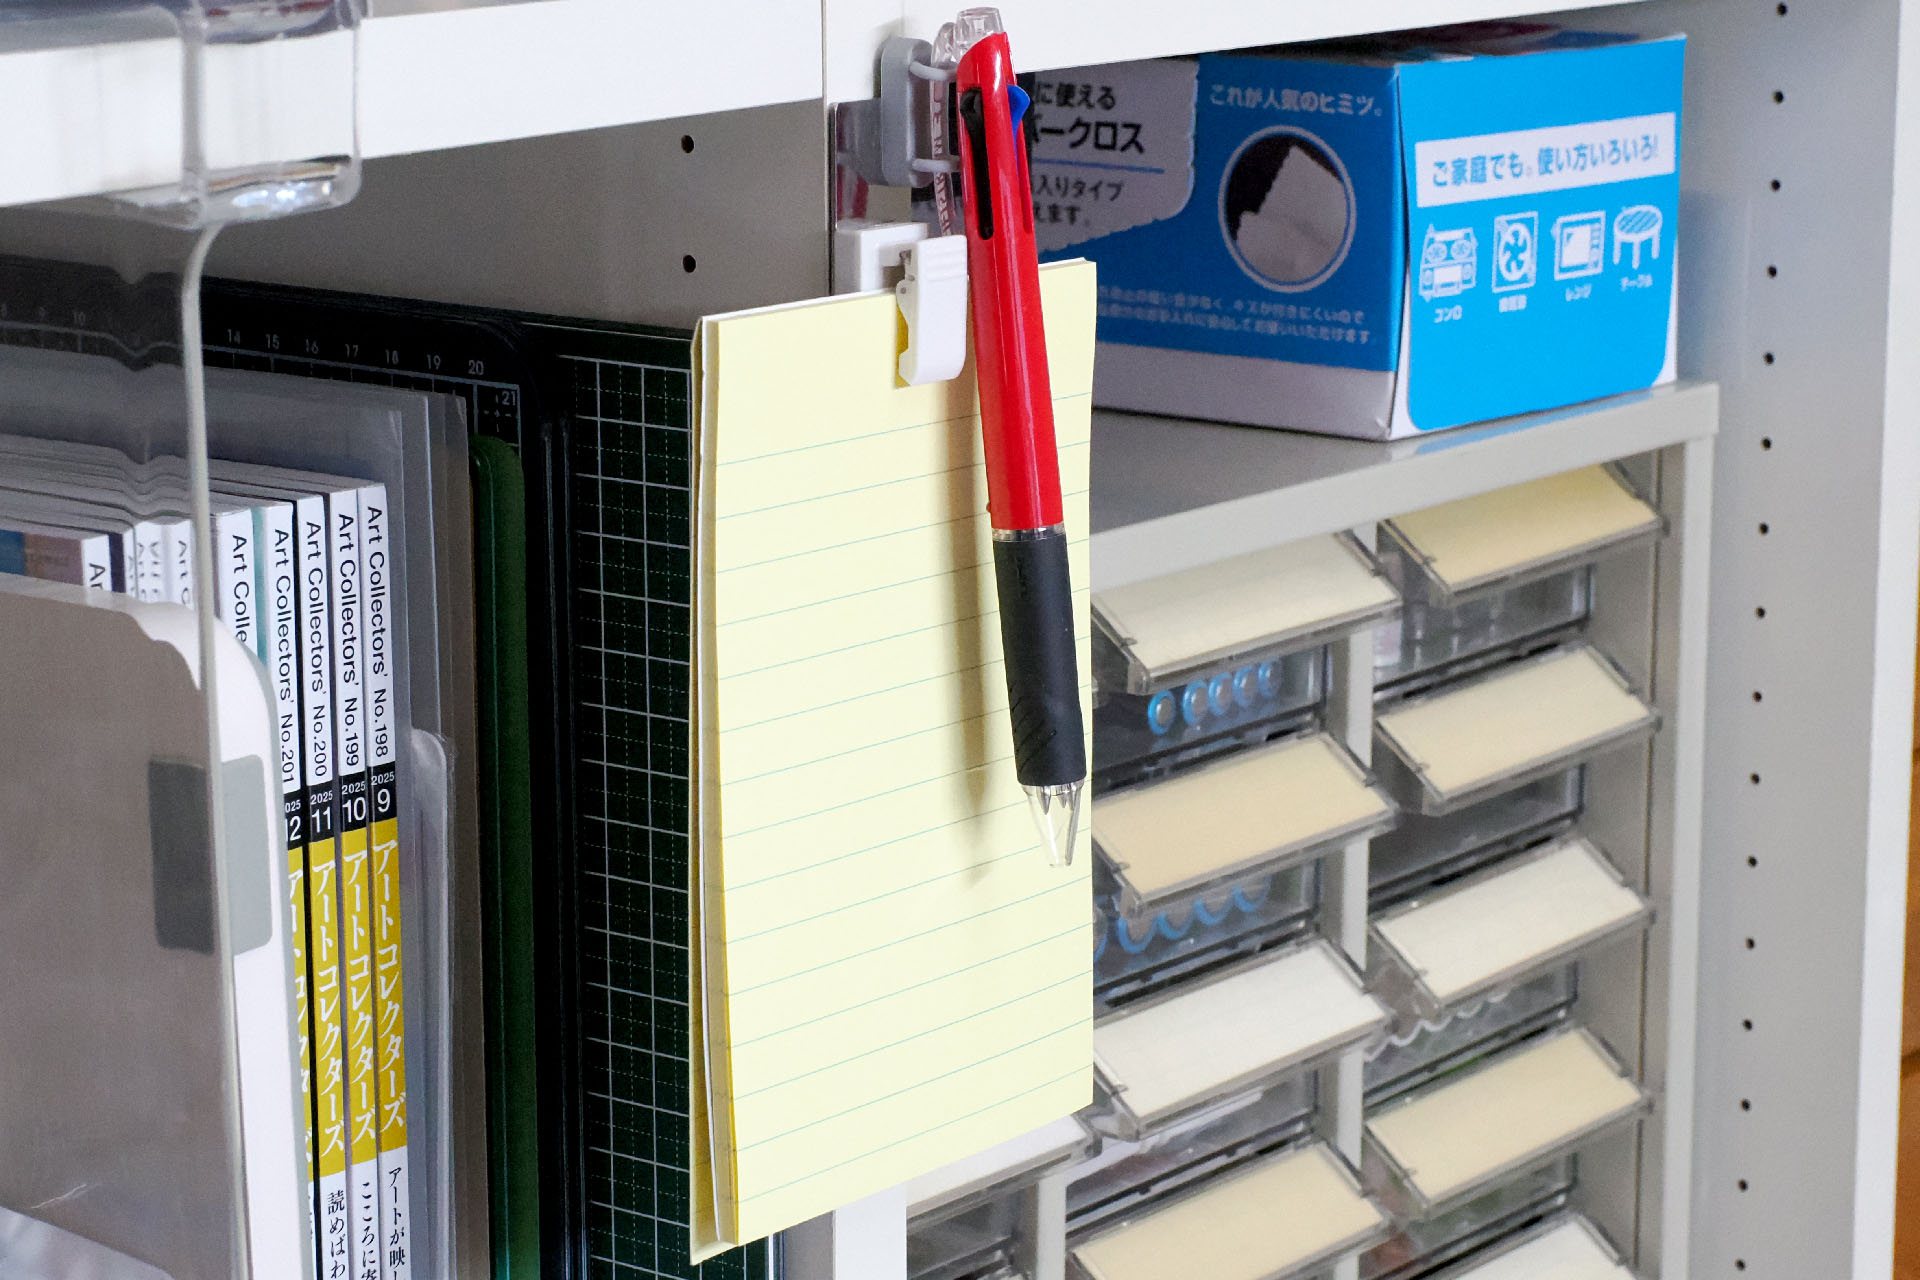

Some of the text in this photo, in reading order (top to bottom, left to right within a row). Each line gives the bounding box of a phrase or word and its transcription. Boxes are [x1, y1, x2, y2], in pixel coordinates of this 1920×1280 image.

[1033, 174, 1124, 202] 入りタイプ
[227, 328, 241, 345] 14
[265, 333, 280, 350] 15
[305, 338, 319, 355] 16
[344, 343, 359, 358] 17
[385, 349, 399, 365] 18
[426, 354, 441, 370] 19
[468, 359, 485, 376] 20
[501, 390, 516, 406] 21
[232, 534, 248, 574] Art
[306, 521, 328, 777] Art Collectors' No.200
[338, 513, 359, 767] Art Collectors' No.199
[367, 506, 389, 758] Art Collectors' No.198
[274, 529, 295, 783] Art Collectors' No.201
[341, 780, 367, 796] 2025
[371, 771, 395, 786] 2025
[285, 799, 302, 814] 025
[310, 789, 334, 806] 2025
[342, 796, 367, 823] 10
[377, 788, 391, 813] 9
[312, 805, 332, 833] 11
[343, 849, 377, 1146] アートコレクターズ
[372, 839, 406, 1133] アートコレクターズ
[311, 859, 346, 1158] アートコレクターズ
